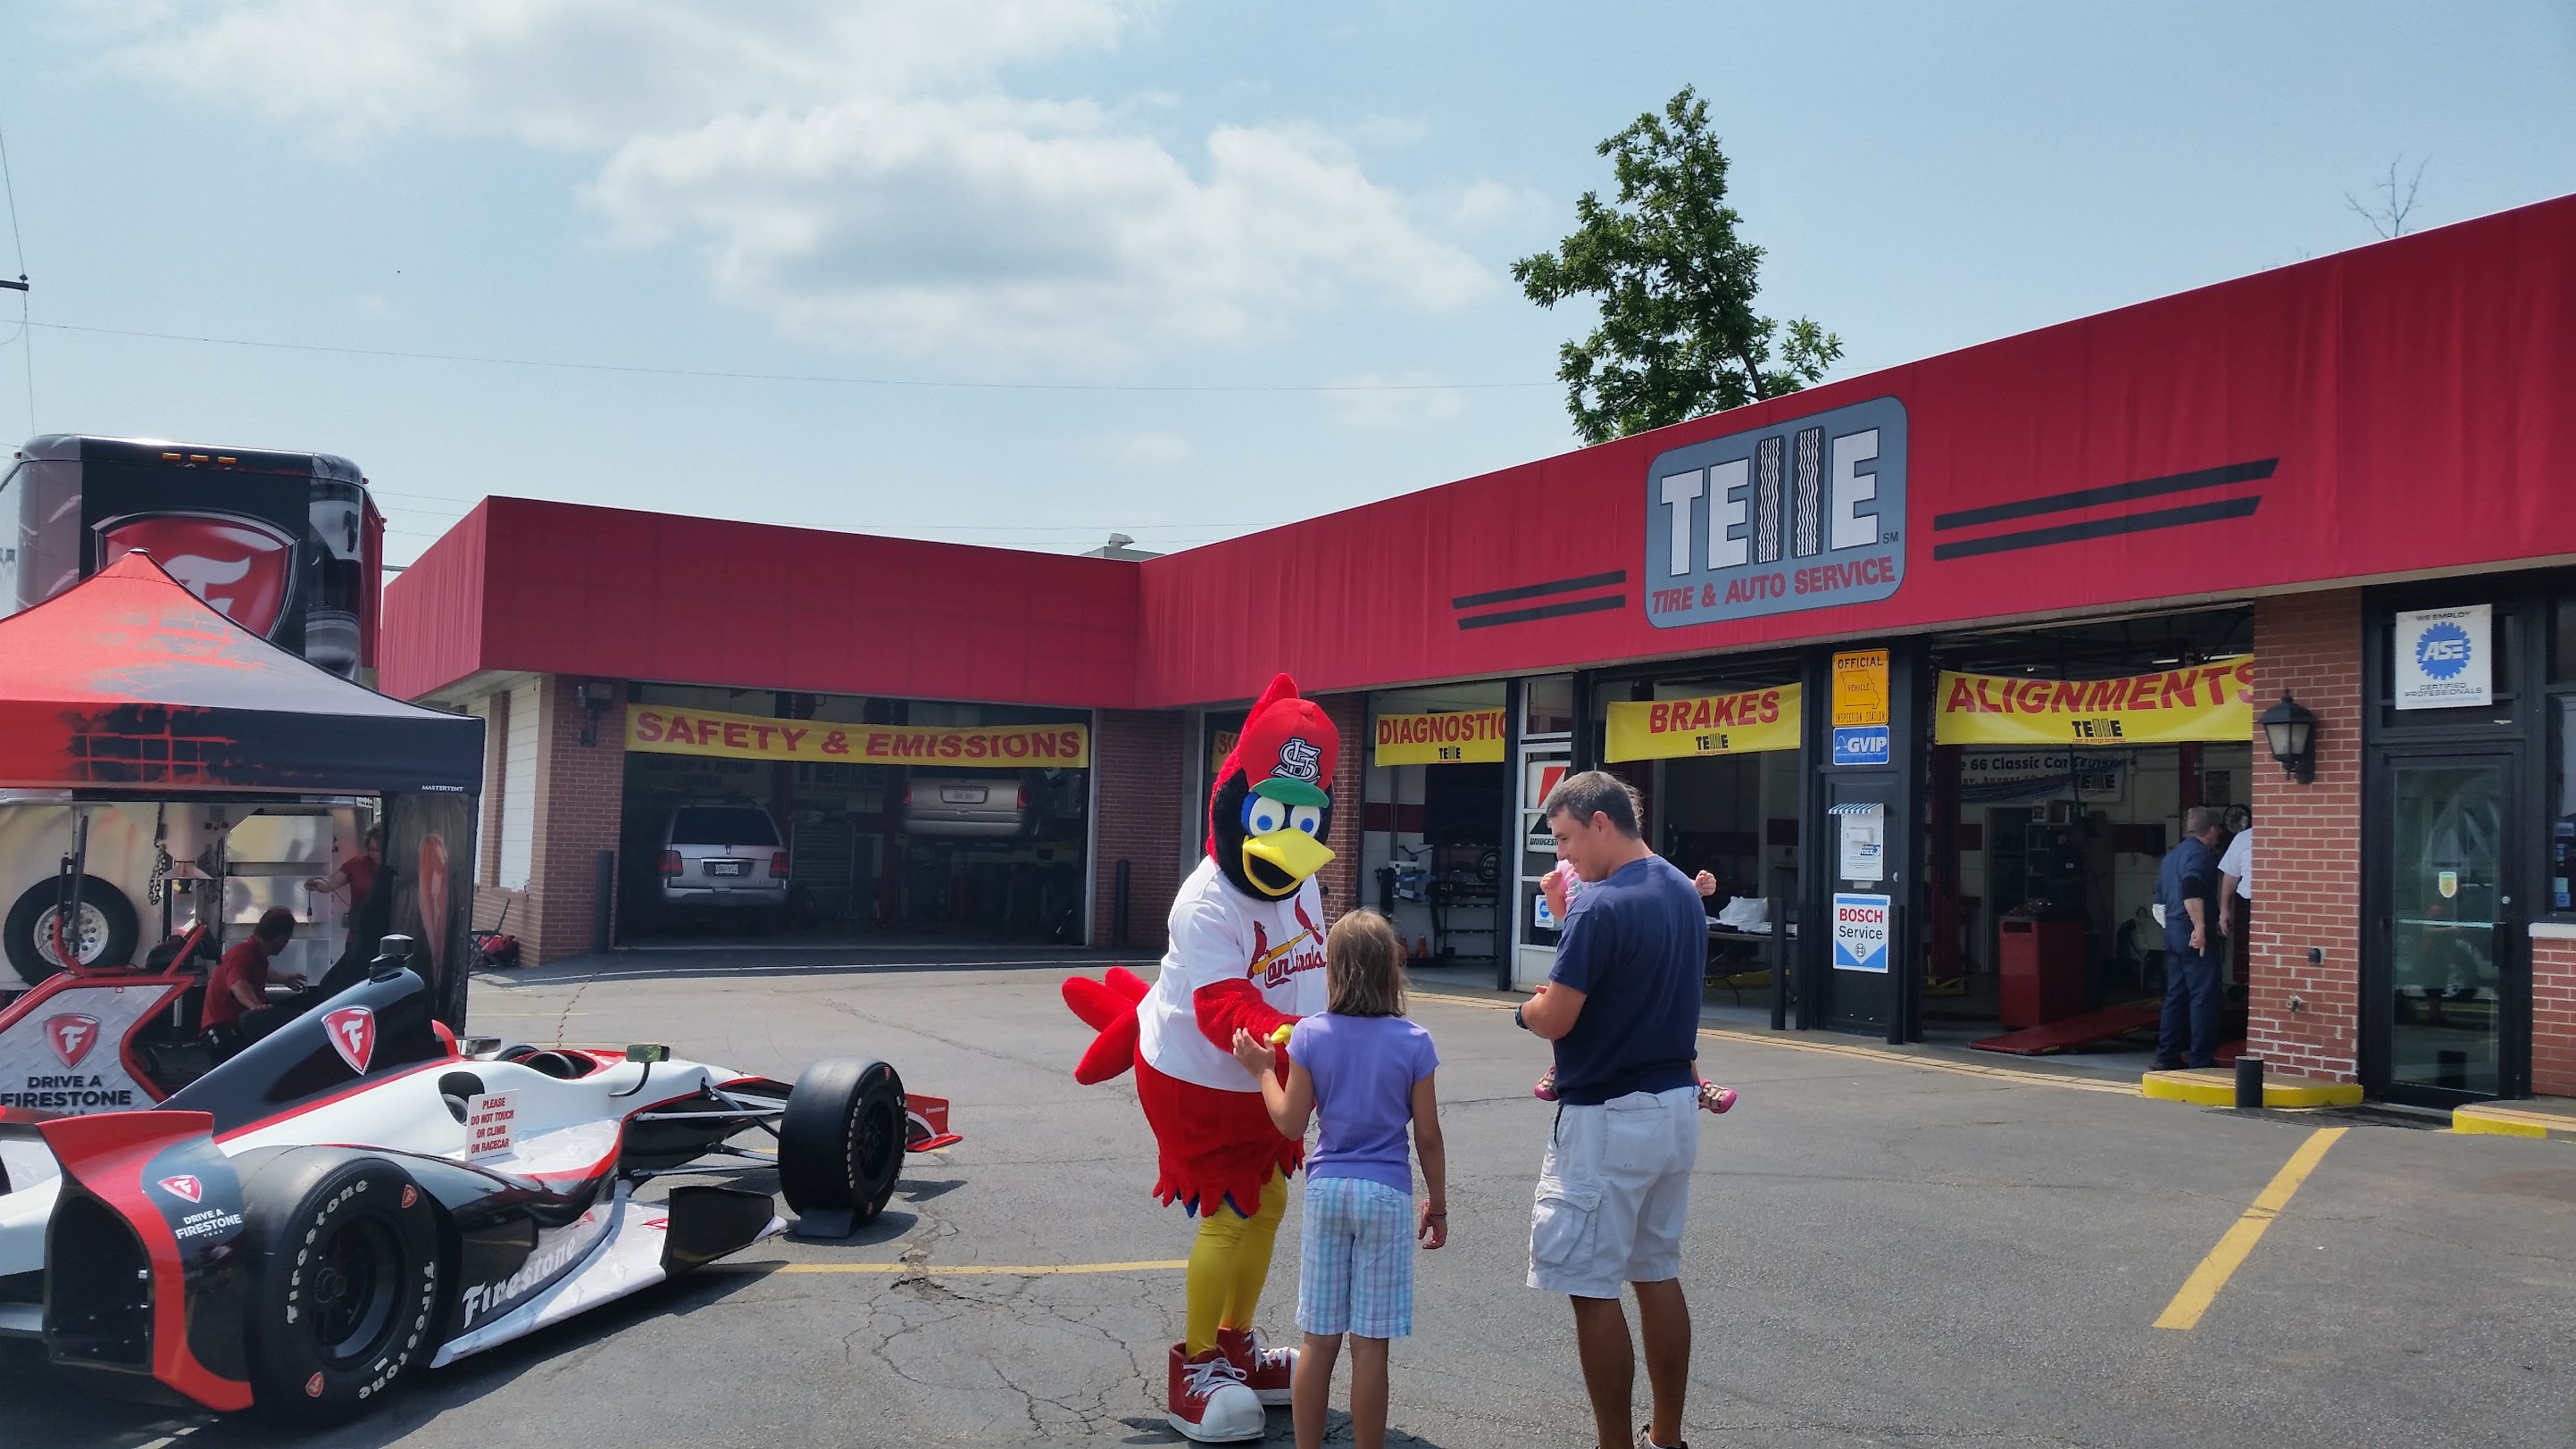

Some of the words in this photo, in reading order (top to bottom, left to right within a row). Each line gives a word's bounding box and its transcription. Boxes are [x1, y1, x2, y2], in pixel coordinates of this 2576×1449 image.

[1882, 531, 1899, 545] SM
[1652, 586, 1694, 614] TIRE
[1701, 583, 1716, 608] &
[1725, 572, 1785, 604] AUTO
[1794, 556, 1896, 595] SERVICE
[2432, 612, 2471, 620] EMPLOY
[2422, 640, 2463, 661] ASE
[1838, 656, 1883, 669] OFFICIAL
[1847, 684, 1870, 692] VEHICLE
[1946, 662, 2254, 713] ALIGNMENTS
[2405, 687, 2482, 697] PROFESSIONALS
[2420, 682, 2466, 690] CERTIFIED
[1649, 691, 1780, 734] BRAKES
[1836, 712, 1863, 723] INSPECTION
[1866, 711, 1886, 721] STATION
[636, 712, 809, 751] SAFETY
[821, 730, 849, 754] &
[866, 731, 1080, 758] EMISSIONS
[1847, 737, 1887, 753] GVIP
[1971, 758, 1988, 770] 66
[1992, 756, 2039, 770] Classic
[2044, 757, 2069, 769] Car
[1839, 908, 1883, 923] BOSCH
[1838, 925, 1883, 939] Service
[27, 1076, 84, 1088] DRIVE
[89, 1075, 103, 1087] A
[0, 1090, 131, 1107] FIRESTONE
[482, 1097, 505, 1109] PLEASE
[471, 1115, 479, 1126] DO
[481, 1113, 494, 1124] NOT
[495, 1110, 514, 1121] TOUCH
[477, 1128, 486, 1138] OR
[487, 1125, 506, 1137] CLIMB
[471, 1144, 480, 1153] ON
[481, 1138, 510, 1153] RACECAR
[183, 1211, 215, 1225] DRIVE
[216, 1208, 225, 1216] A
[175, 1214, 243, 1239] FIRESTONE
[462, 1236, 577, 1328] Firestone
